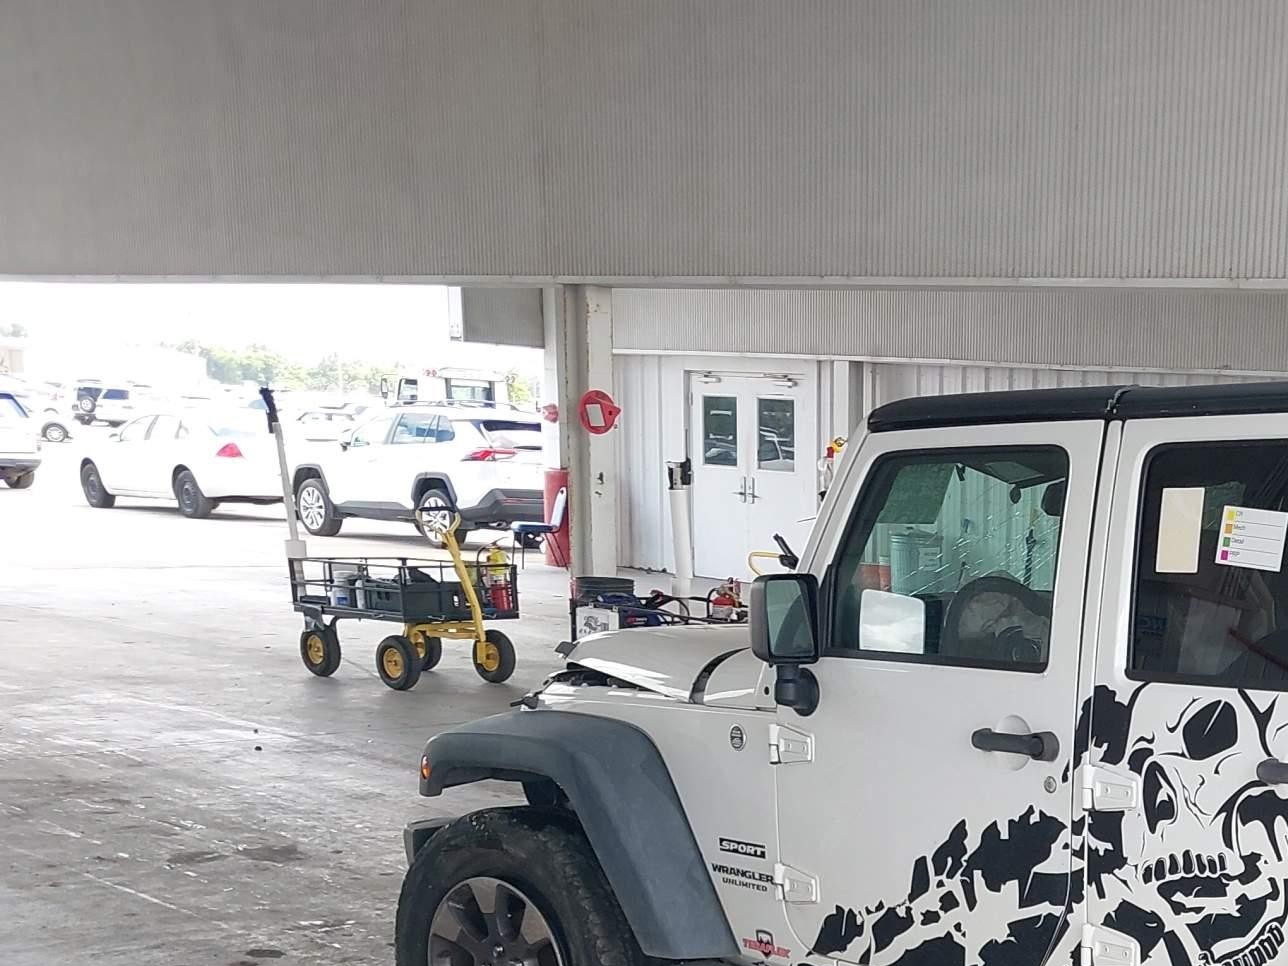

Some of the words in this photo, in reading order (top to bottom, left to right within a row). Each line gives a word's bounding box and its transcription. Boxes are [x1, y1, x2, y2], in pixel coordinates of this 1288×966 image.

[720, 840, 763, 856] SPORT
[711, 863, 775, 884] WRANGLER
[722, 877, 768, 892] UNLIMITED
